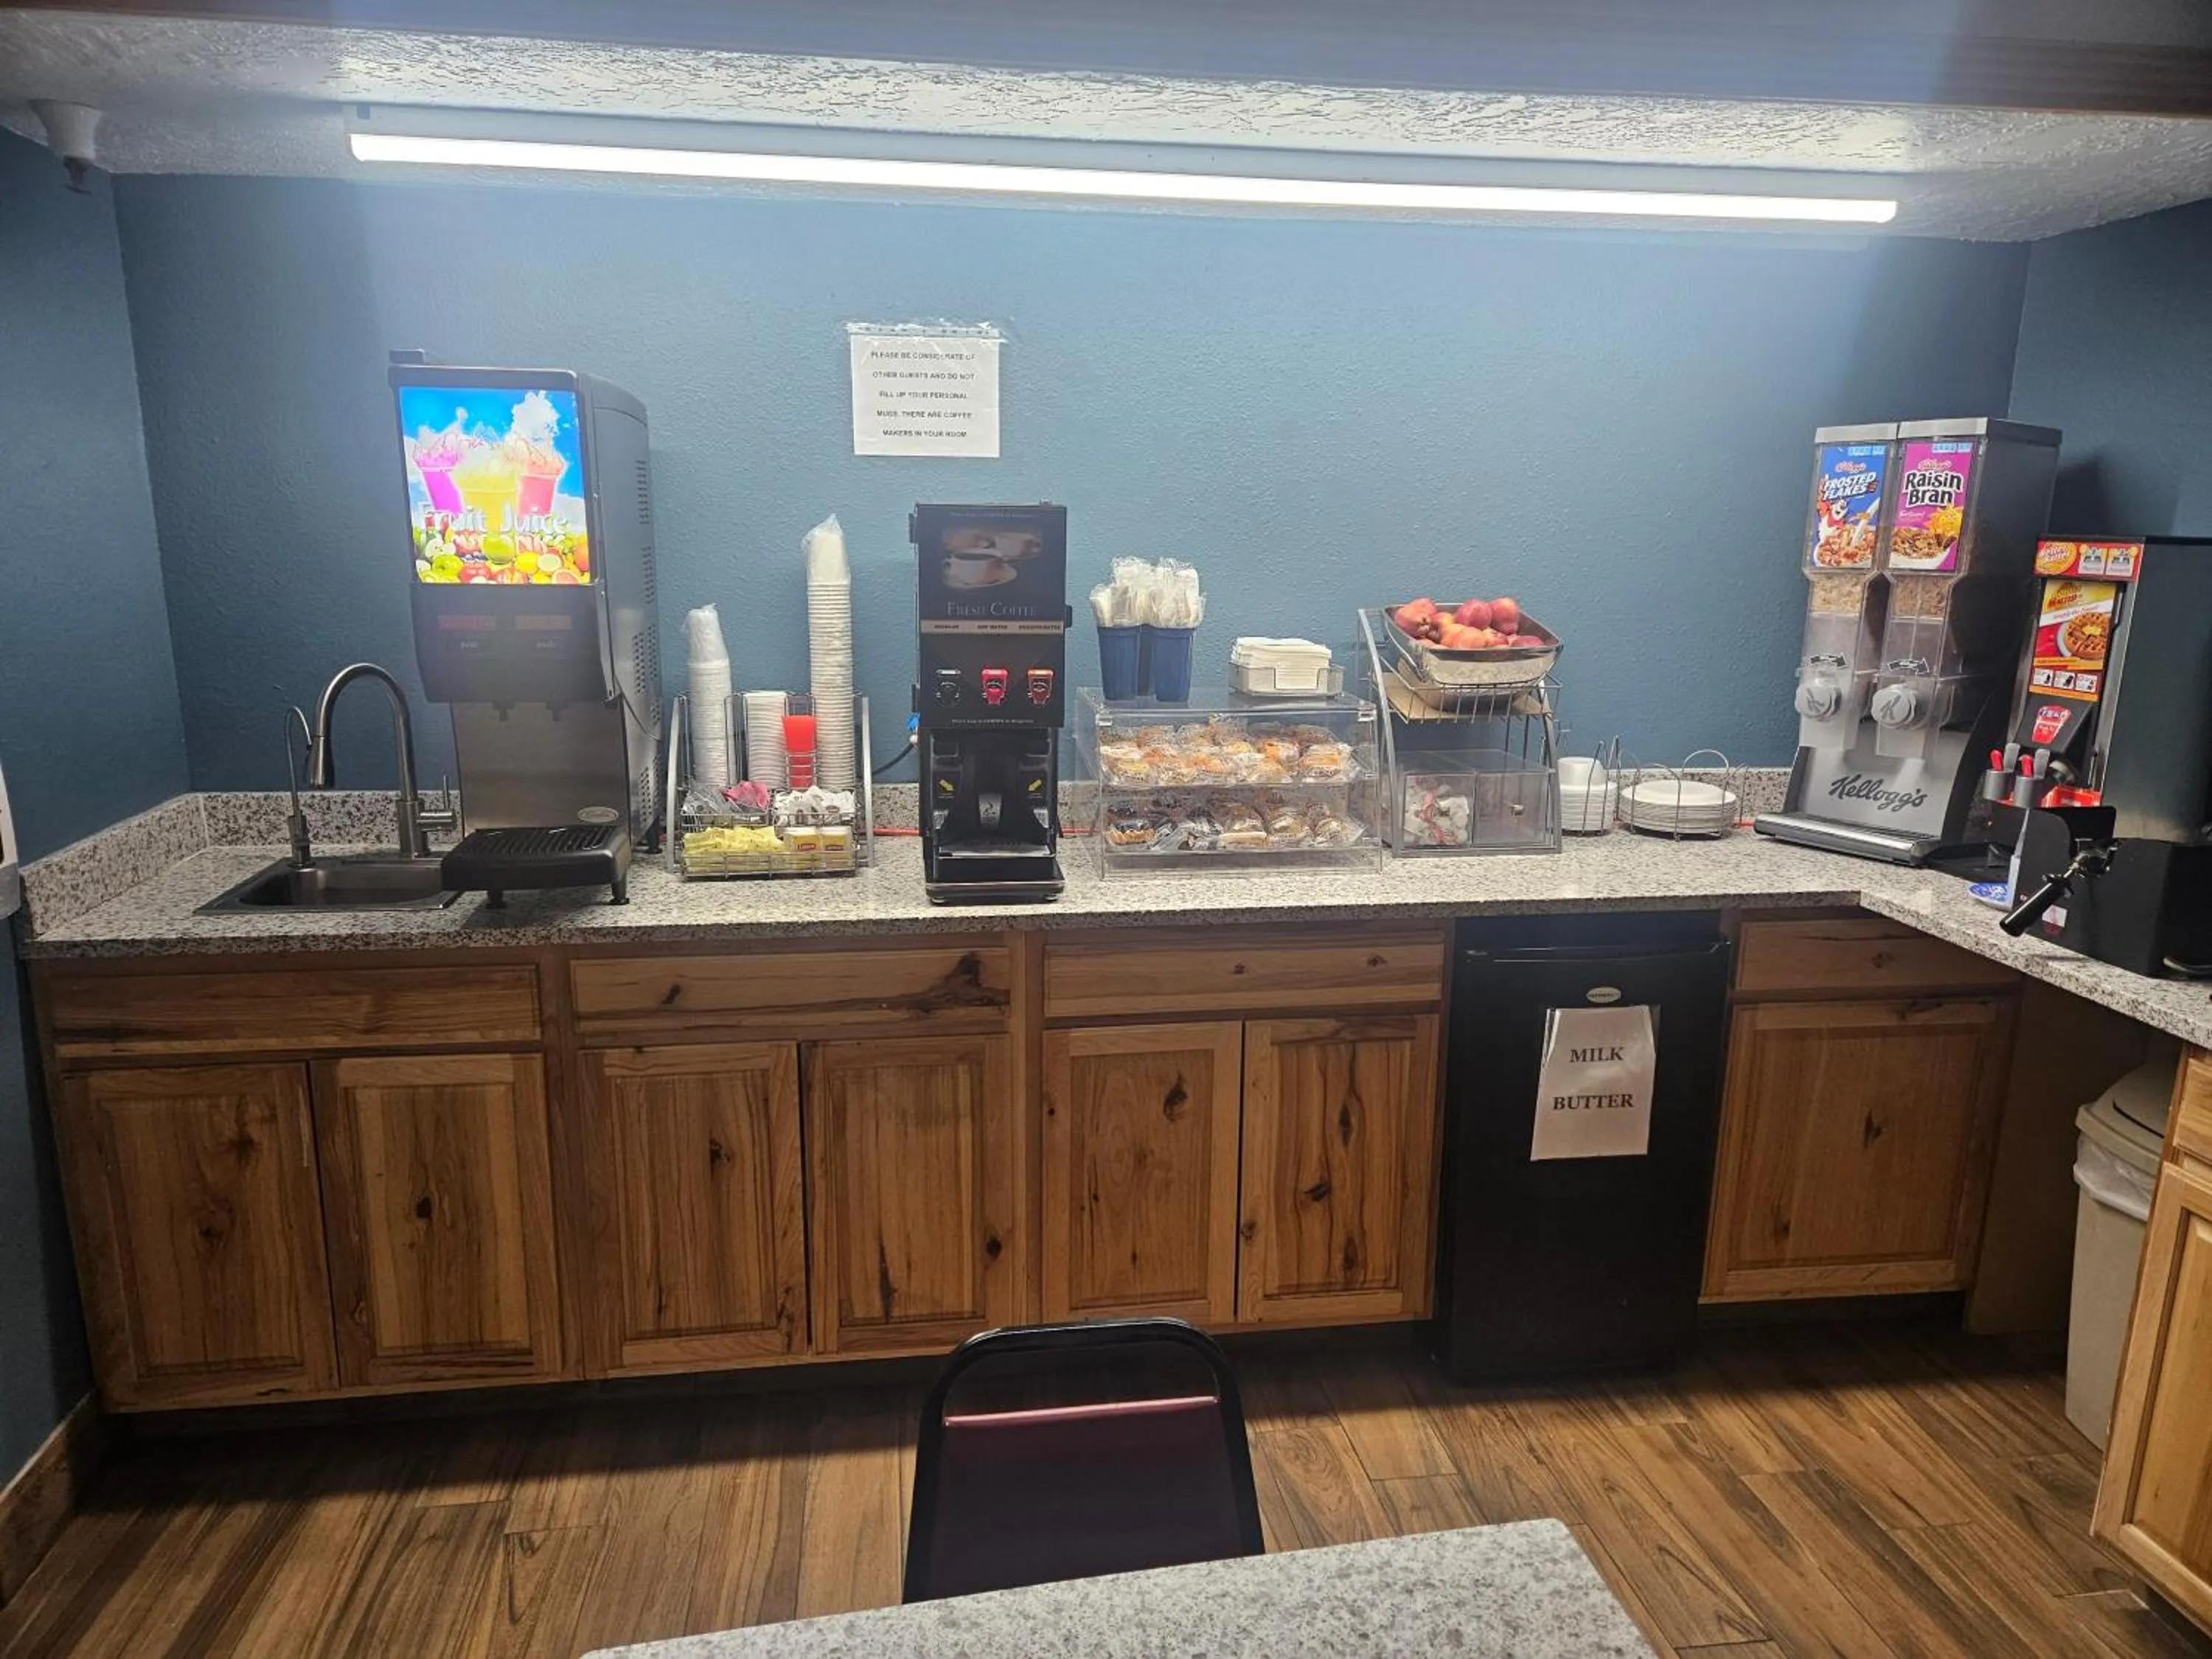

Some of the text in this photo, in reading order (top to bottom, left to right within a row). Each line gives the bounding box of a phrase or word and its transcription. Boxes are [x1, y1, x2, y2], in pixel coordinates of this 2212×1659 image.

[871, 352, 898, 360] PLEASE
[872, 371, 897, 379] OTHER
[944, 411, 973, 420] COFFEE
[1824, 472, 1876, 489] FROSTED
[1905, 472, 1962, 490] Raisin
[1823, 484, 1868, 499] FLAKES
[1908, 487, 1954, 506] Bran
[420, 501, 568, 535] Fruit Juice
[1829, 774, 1927, 812] Kellogg's
[1569, 1047, 1625, 1062] MILK
[1553, 1093, 1635, 1110] BUTTER
